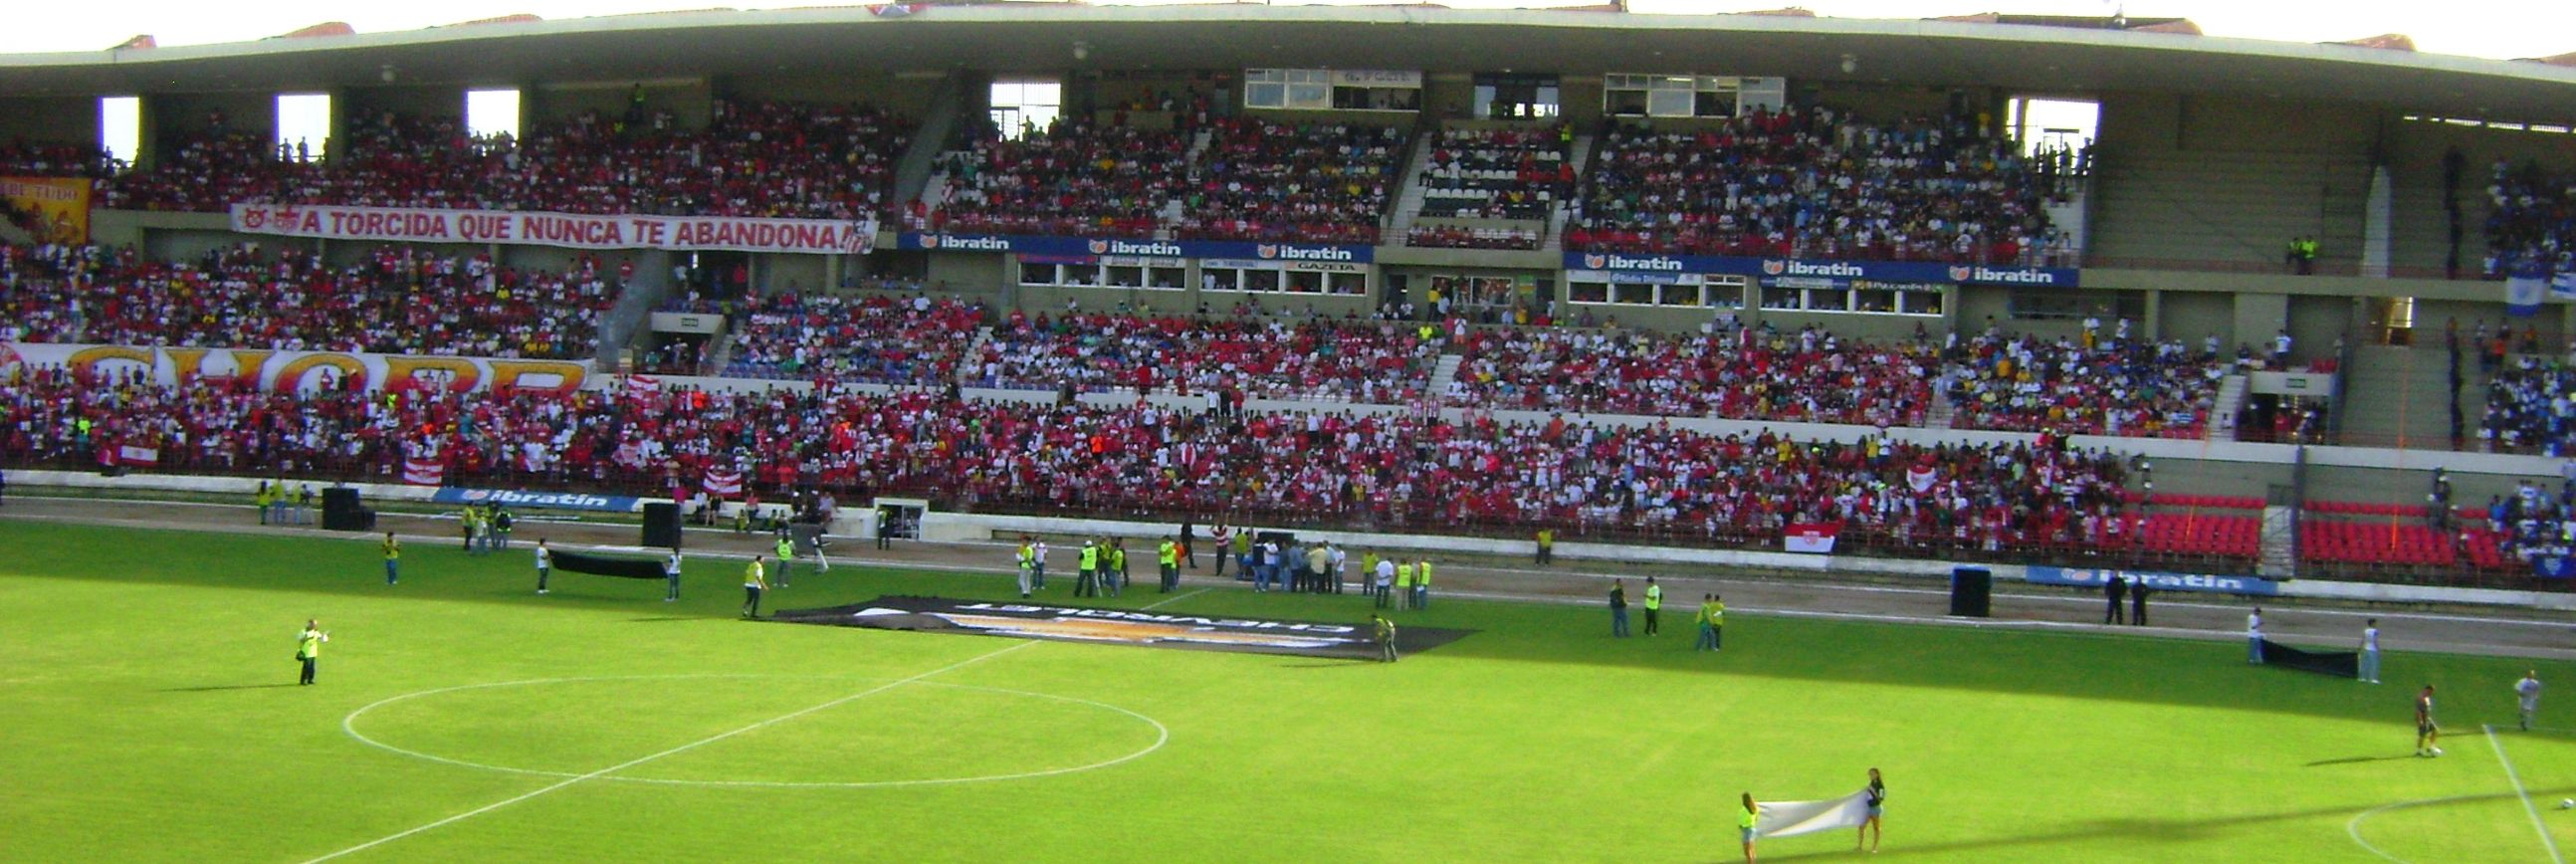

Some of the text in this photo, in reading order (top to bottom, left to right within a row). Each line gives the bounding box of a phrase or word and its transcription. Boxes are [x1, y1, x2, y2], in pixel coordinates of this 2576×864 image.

[303, 210, 321, 232] A
[330, 211, 447, 238] TORCIDA
[459, 214, 511, 240] QUE
[523, 217, 623, 245] NUNCA
[632, 219, 665, 245] TE
[941, 234, 1009, 249] ibratin
[1111, 240, 1181, 256] ibratin
[1280, 245, 1352, 260] ibratin
[1609, 255, 1682, 270] ibratin
[1788, 261, 1863, 276] ibratin
[1975, 267, 2052, 283] ibratin
[490, 490, 607, 506] ibratin
